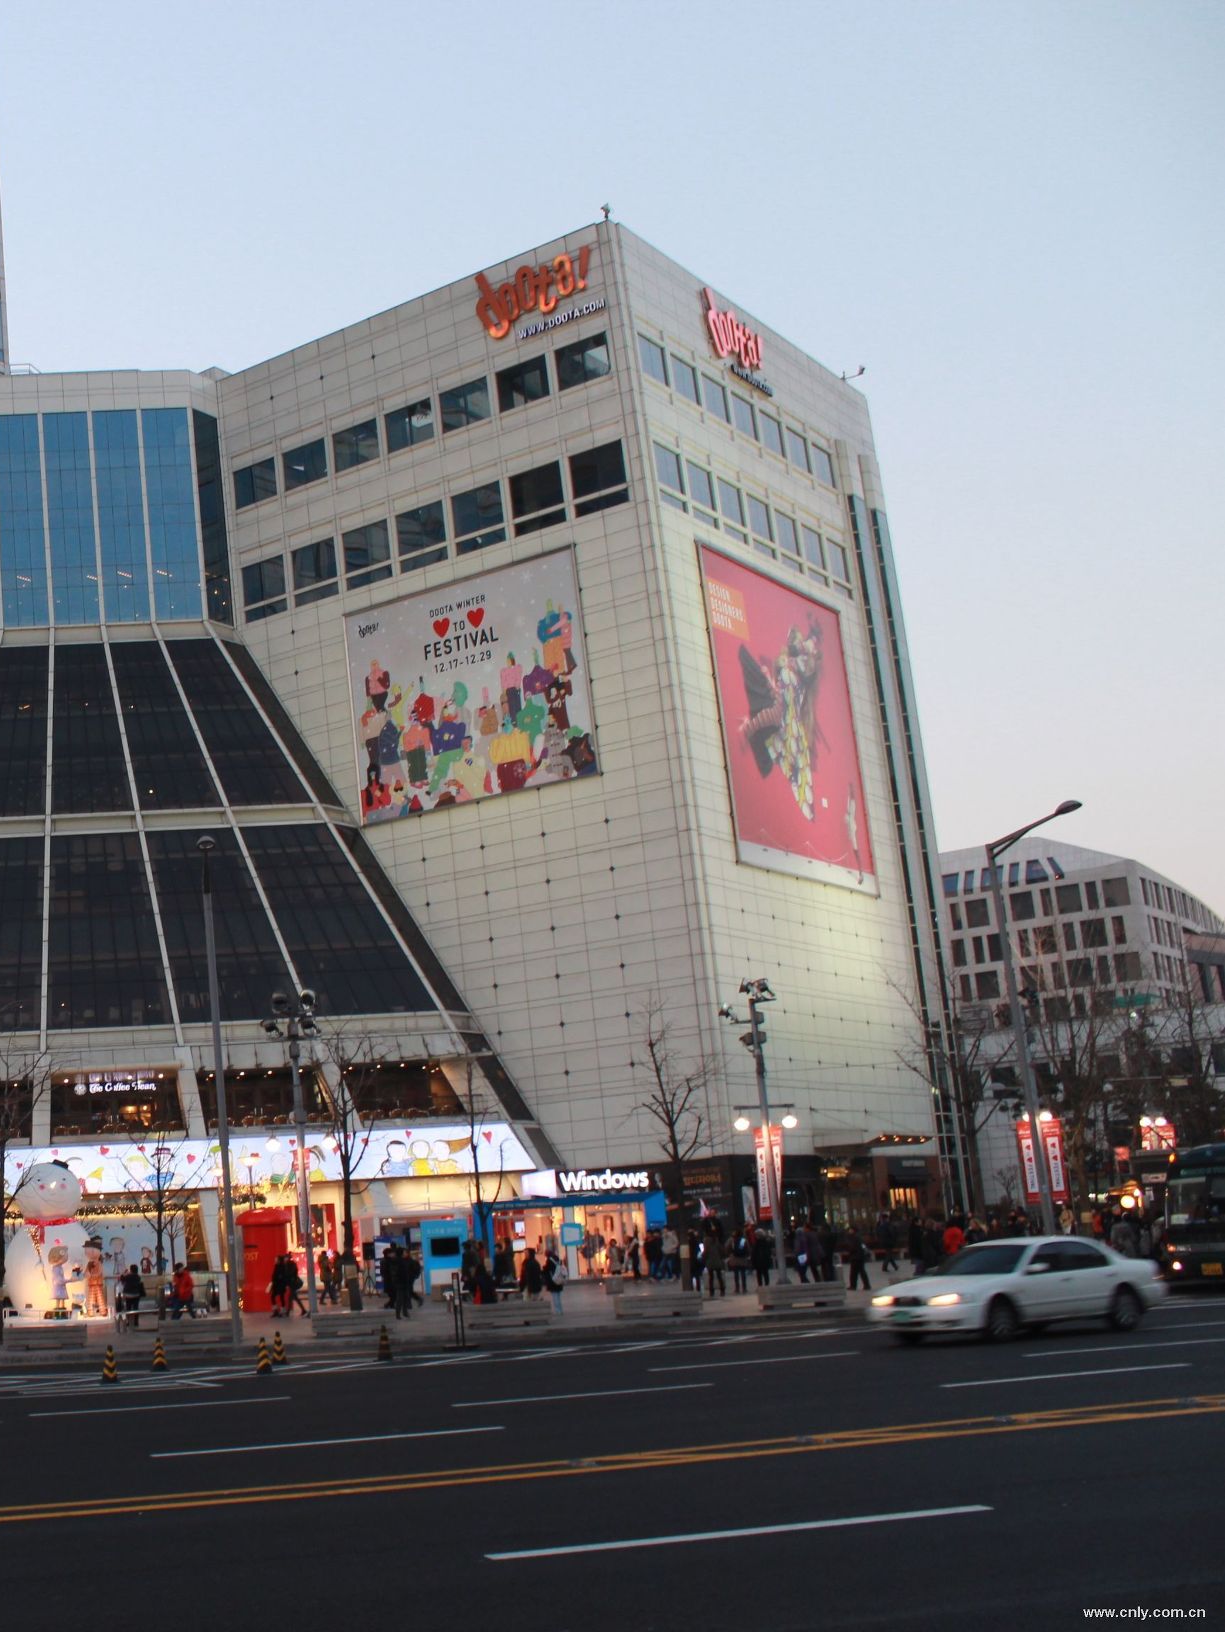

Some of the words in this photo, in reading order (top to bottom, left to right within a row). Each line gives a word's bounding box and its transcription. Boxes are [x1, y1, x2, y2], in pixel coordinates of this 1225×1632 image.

[475, 246, 591, 339] doota!
[518, 298, 606, 340] WWW.DOOTA.COM
[429, 605, 453, 618] DOOTA
[456, 594, 486, 609] WINTER
[453, 620, 465, 632] TO
[424, 626, 499, 660] FESTIVAL
[434, 650, 492, 674] 12.17-12.29
[105, 1083, 130, 1092] Cffee
[559, 1169, 649, 1192] Windows
